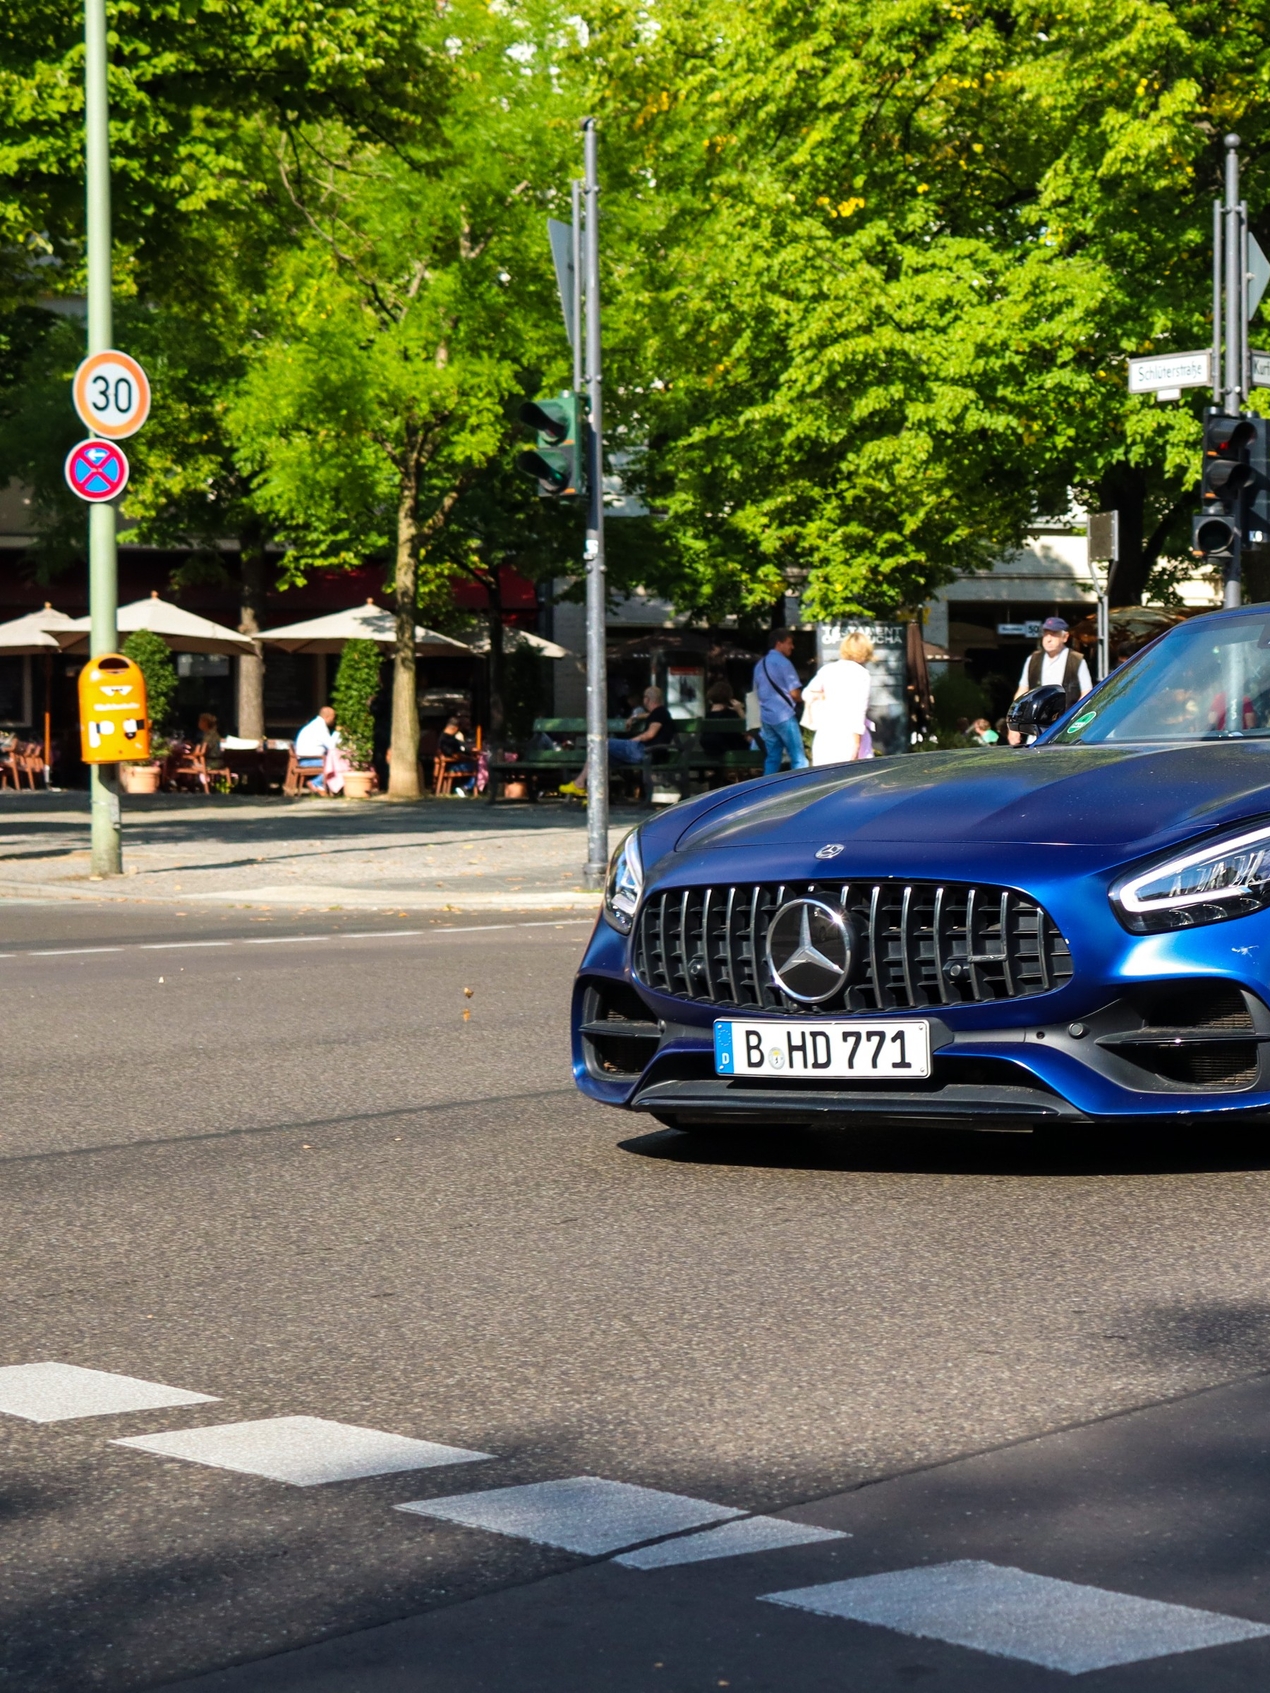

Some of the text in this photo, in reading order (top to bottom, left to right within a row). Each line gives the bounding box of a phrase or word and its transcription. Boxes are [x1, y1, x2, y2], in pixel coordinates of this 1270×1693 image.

[1138, 361, 1202, 382] Schlüterstraße
[92, 375, 132, 413] 30
[721, 1053, 730, 1064] D
[745, 1030, 912, 1069] B HD 771
